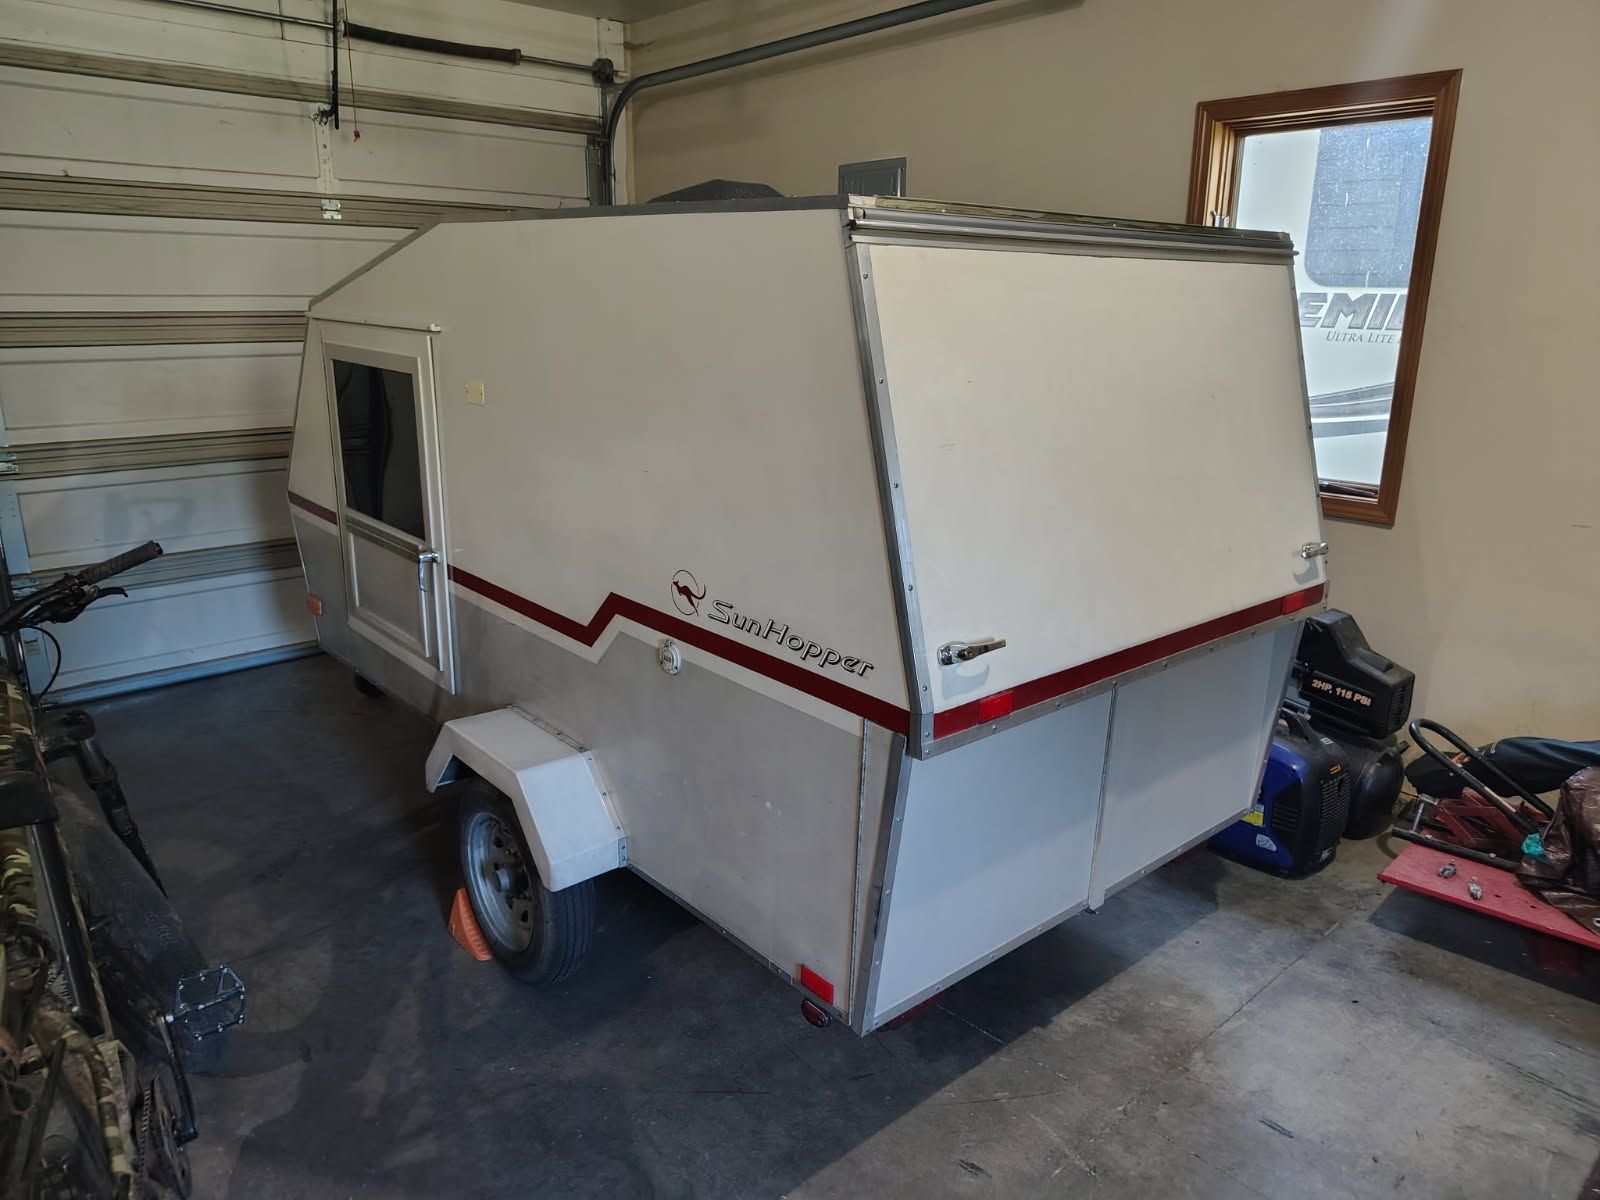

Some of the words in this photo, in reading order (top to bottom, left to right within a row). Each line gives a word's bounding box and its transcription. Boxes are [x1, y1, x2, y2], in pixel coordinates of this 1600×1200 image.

[1326, 330, 1363, 342] ULTRA
[1368, 332, 1395, 344] LITE
[707, 599, 875, 678] SunHopper
[1336, 688, 1352, 699] 115
[1353, 693, 1371, 706] PSI
